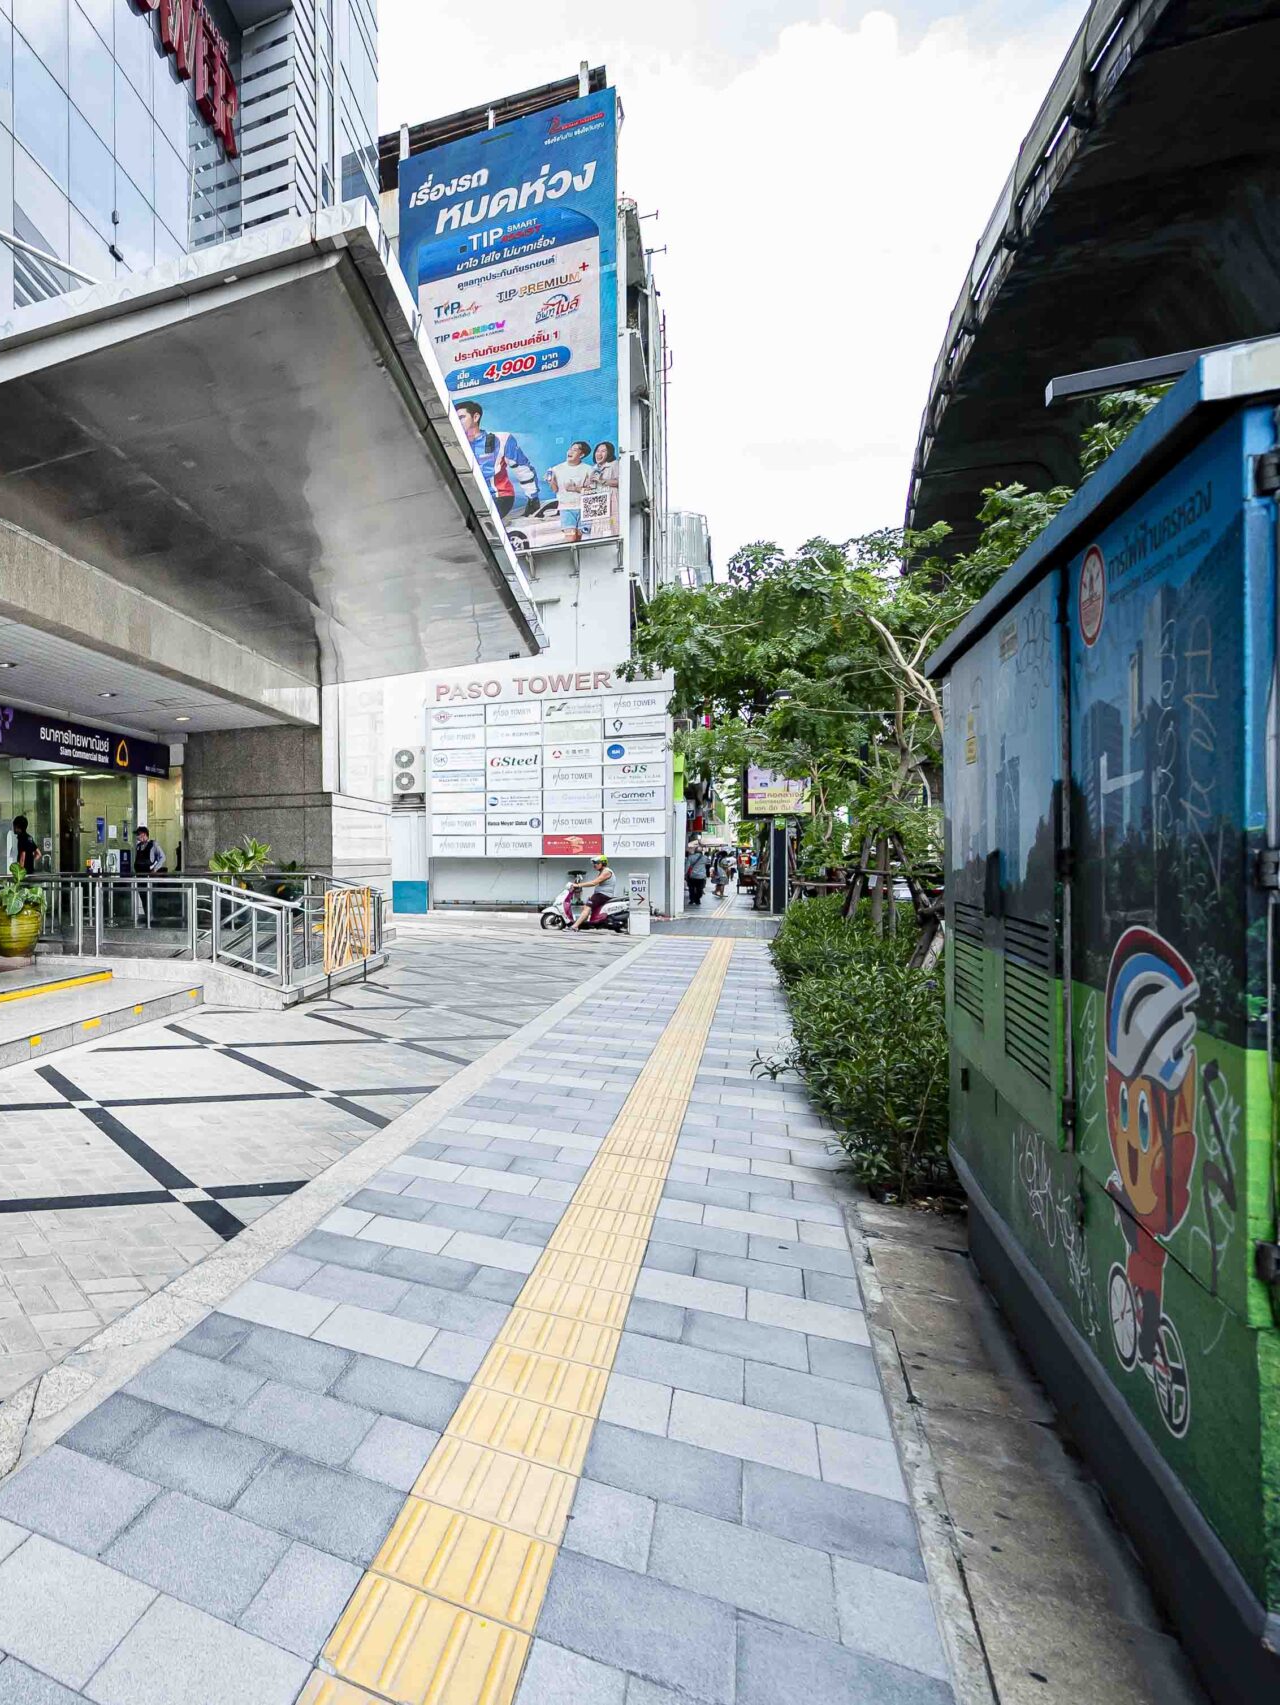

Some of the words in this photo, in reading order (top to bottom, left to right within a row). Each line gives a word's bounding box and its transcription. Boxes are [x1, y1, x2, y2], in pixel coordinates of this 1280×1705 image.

[409, 167, 489, 208] เรื่องรถ
[434, 160, 597, 235] หมดห่วง
[468, 227, 504, 252] TIP
[507, 218, 538, 232] SMART
[497, 288, 518, 303] TIP
[434, 300, 461, 319] TIP
[434, 333, 450, 344] TIP
[451, 320, 506, 341] RAINBOW
[454, 327, 551, 363] ประกันภัยรถยนต์ชั้น
[552, 330, 560, 340] 1
[484, 355, 537, 382] 4,900
[542, 352, 558, 361] บาท
[1108, 480, 1212, 585] การไฟฟ้านครหลวง
[436, 680, 502, 702] PASO
[513, 671, 612, 695] TOWER
[632, 698, 656, 708] TOWER
[39, 726, 110, 752] ธนาคารไทยพาณิชย์
[59, 746, 71, 756] Siam
[72, 750, 97, 762] Commercial
[98, 753, 109, 764] Bank
[490, 754, 538, 768] GSteel
[571, 772, 593, 780] TOWER
[622, 764, 648, 774] GJS
[571, 818, 593, 826] TOWER
[632, 816, 655, 825] TOWER
[512, 841, 533, 849] TOWER
[632, 840, 655, 848] TOWER
